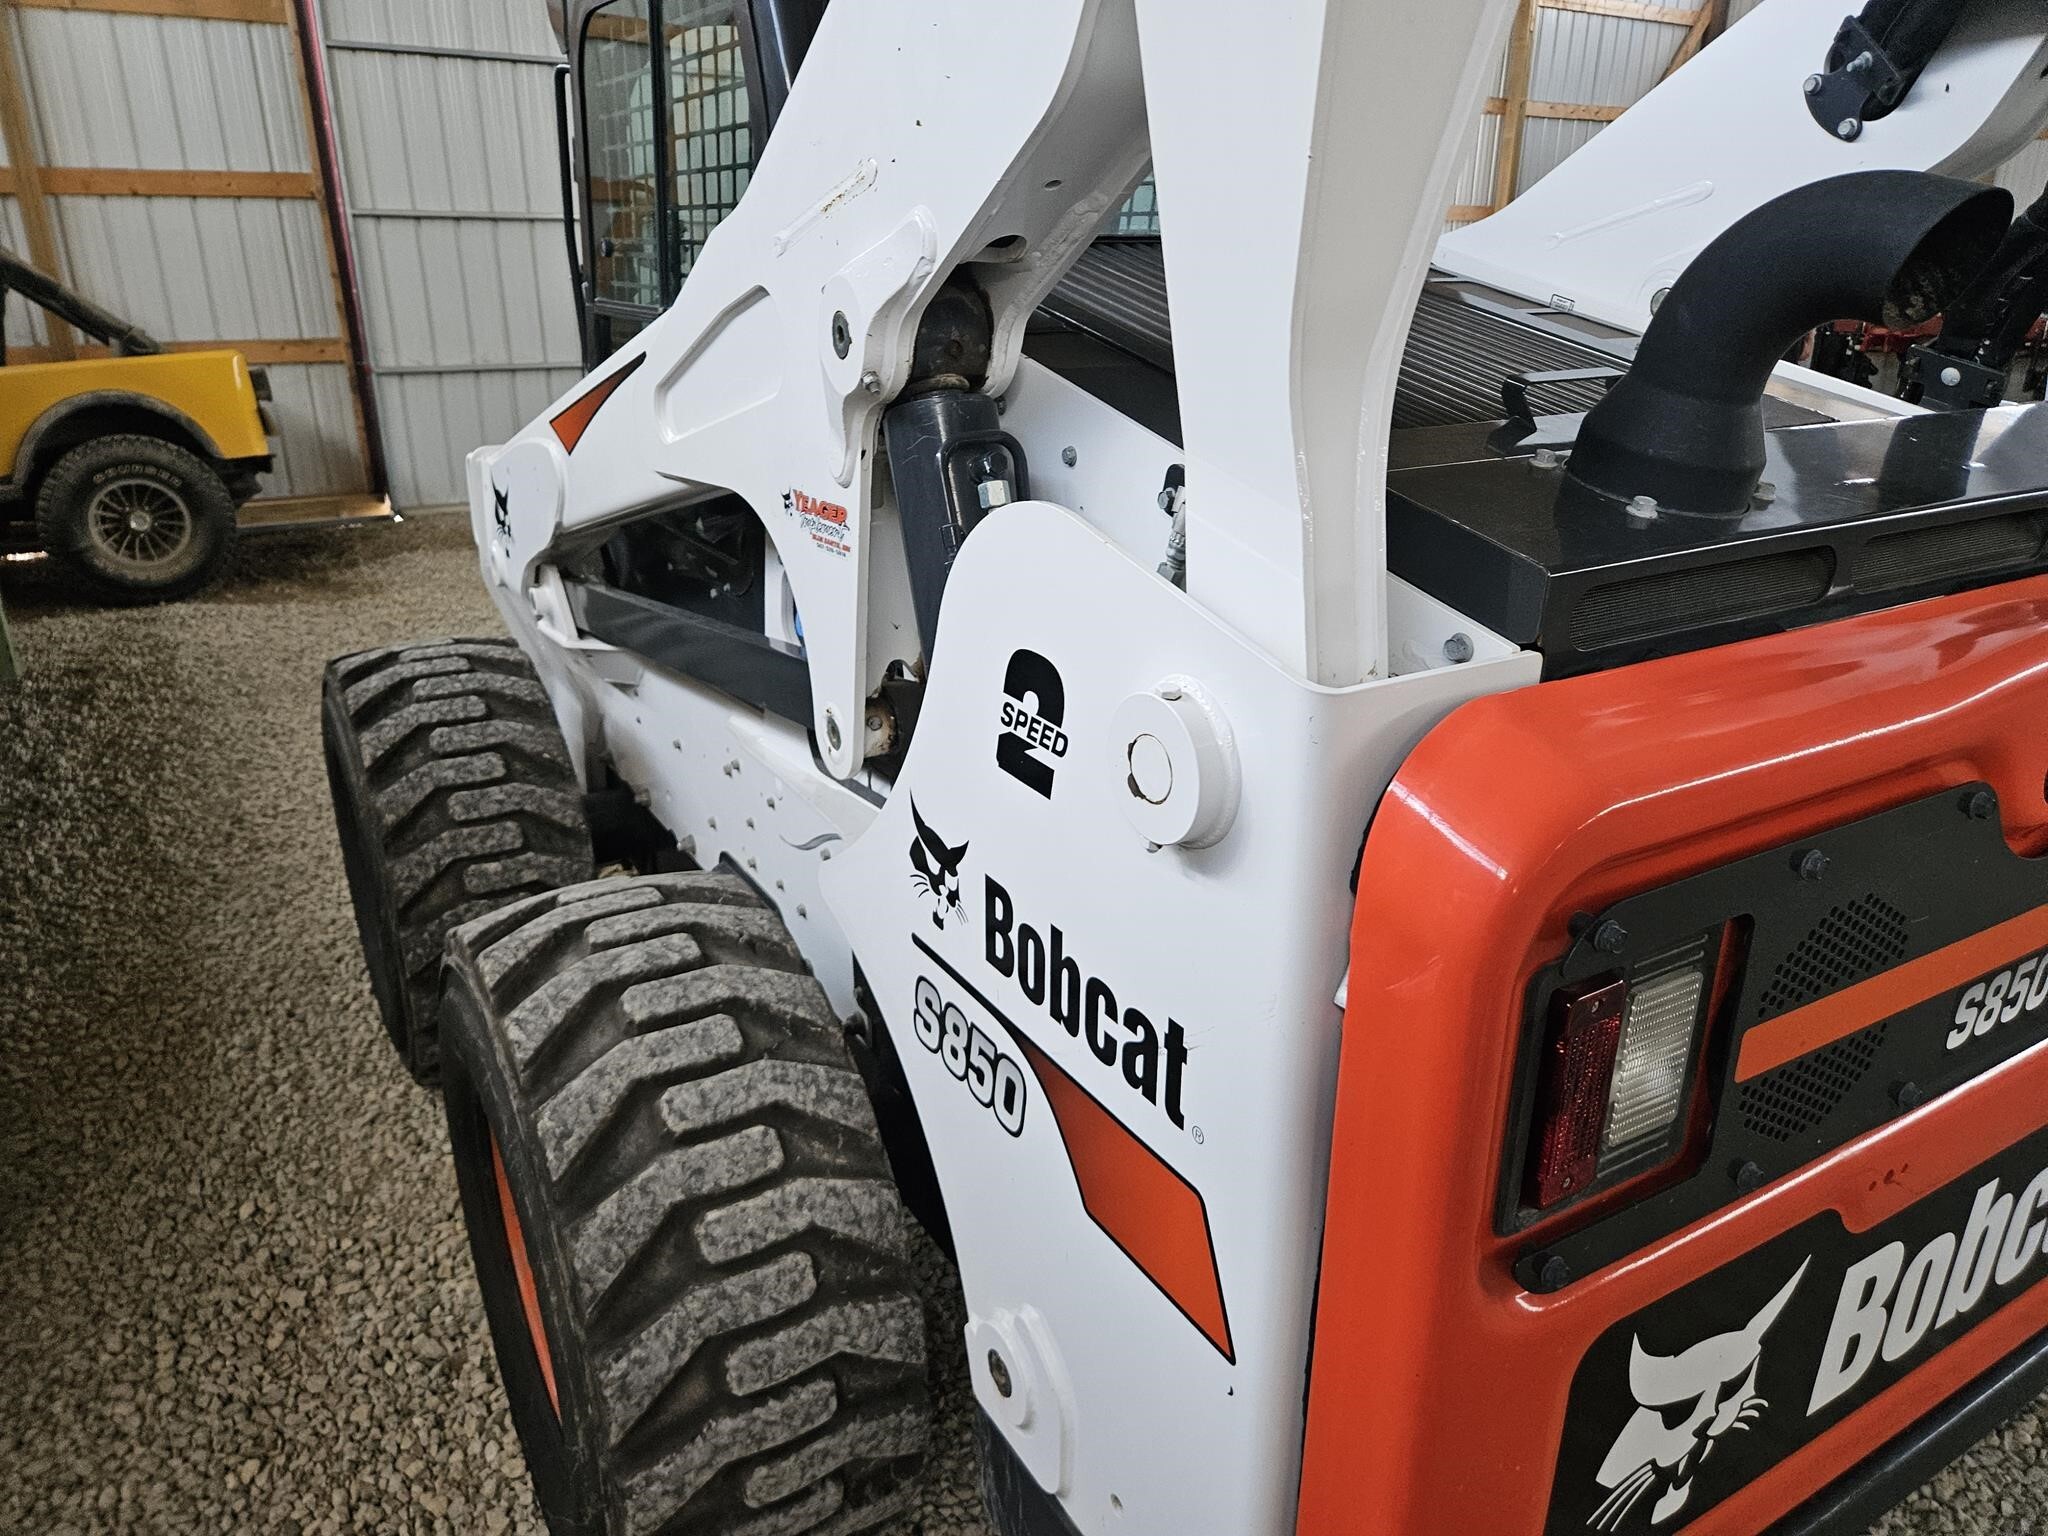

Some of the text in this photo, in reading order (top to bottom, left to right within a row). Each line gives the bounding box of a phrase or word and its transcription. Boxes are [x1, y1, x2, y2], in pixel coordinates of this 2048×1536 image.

[792, 489, 848, 524] YEAGER
[996, 648, 1065, 800] 2
[1000, 701, 1069, 758] SPEED
[913, 974, 1027, 1138] S850
[985, 873, 1188, 1131] Bobcat
[1806, 1166, 2048, 1416] Bobc
